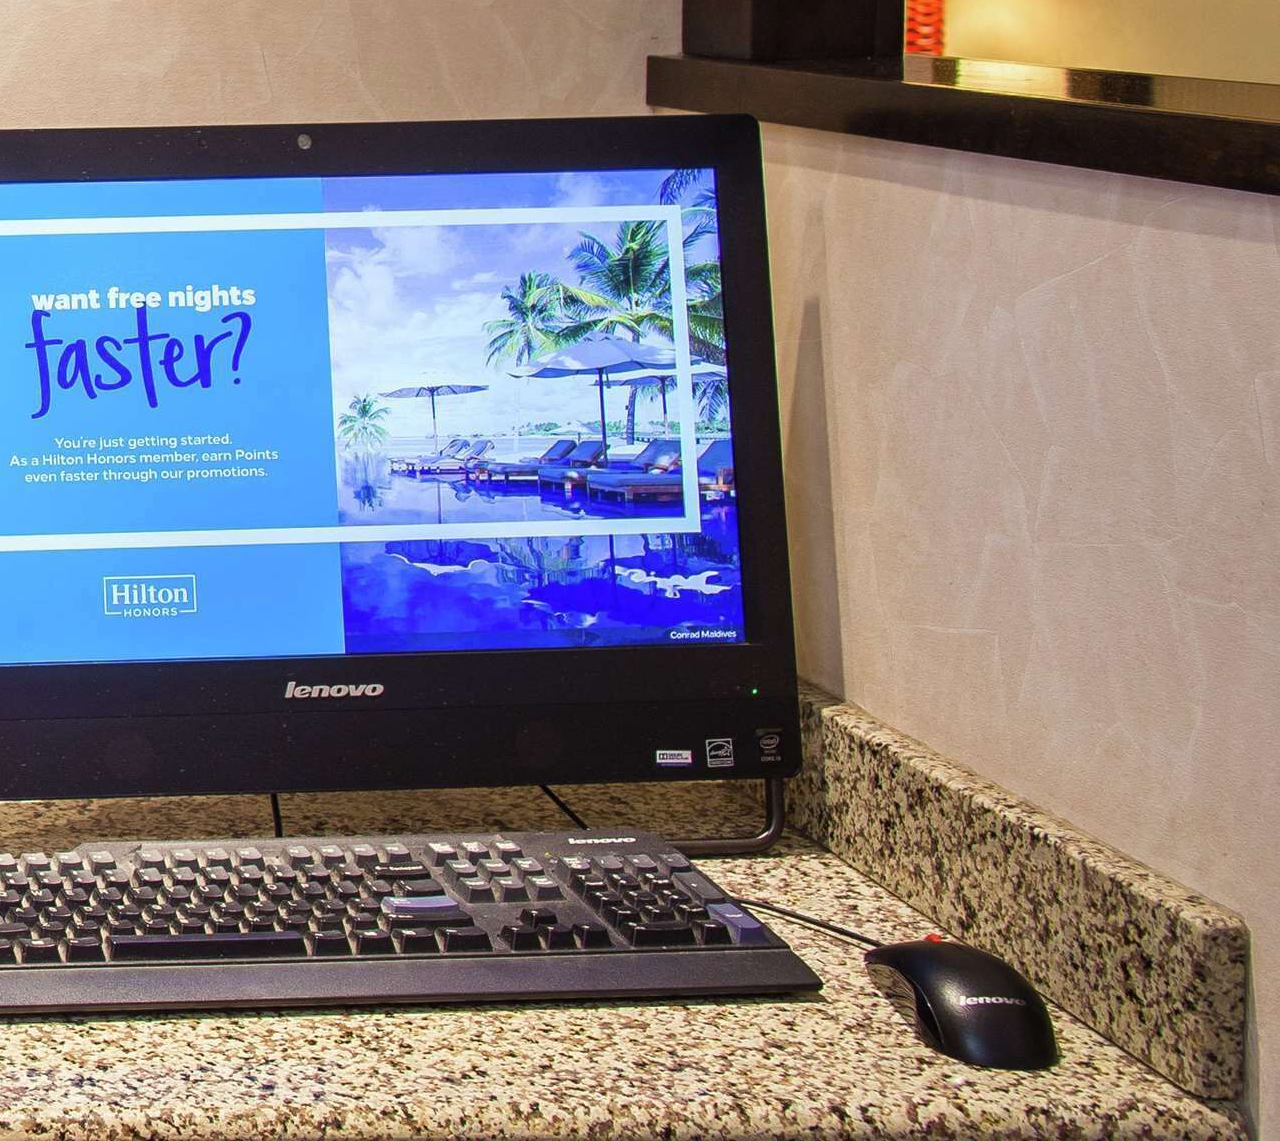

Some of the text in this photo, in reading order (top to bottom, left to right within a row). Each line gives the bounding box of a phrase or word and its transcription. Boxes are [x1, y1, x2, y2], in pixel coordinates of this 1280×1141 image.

[31, 284, 257, 312] want free nights
[25, 302, 252, 419] faster?
[98, 436, 124, 449] just
[128, 436, 177, 449] getting
[180, 433, 233, 446] started.
[9, 455, 27, 466] As
[31, 458, 39, 466] a
[42, 454, 84, 466] Hilton
[87, 453, 137, 465] Honors
[202, 451, 232, 461] earn
[236, 448, 279, 461] Points
[25, 467, 269, 483] even faster through our promotions.
[112, 583, 189, 605] Hilton
[123, 607, 178, 617] HONORS
[670, 630, 737, 639] Conrad Maldives
[285, 681, 384, 698] lenovo
[567, 836, 637, 845] lenovo
[959, 995, 1026, 1006] lenovo
